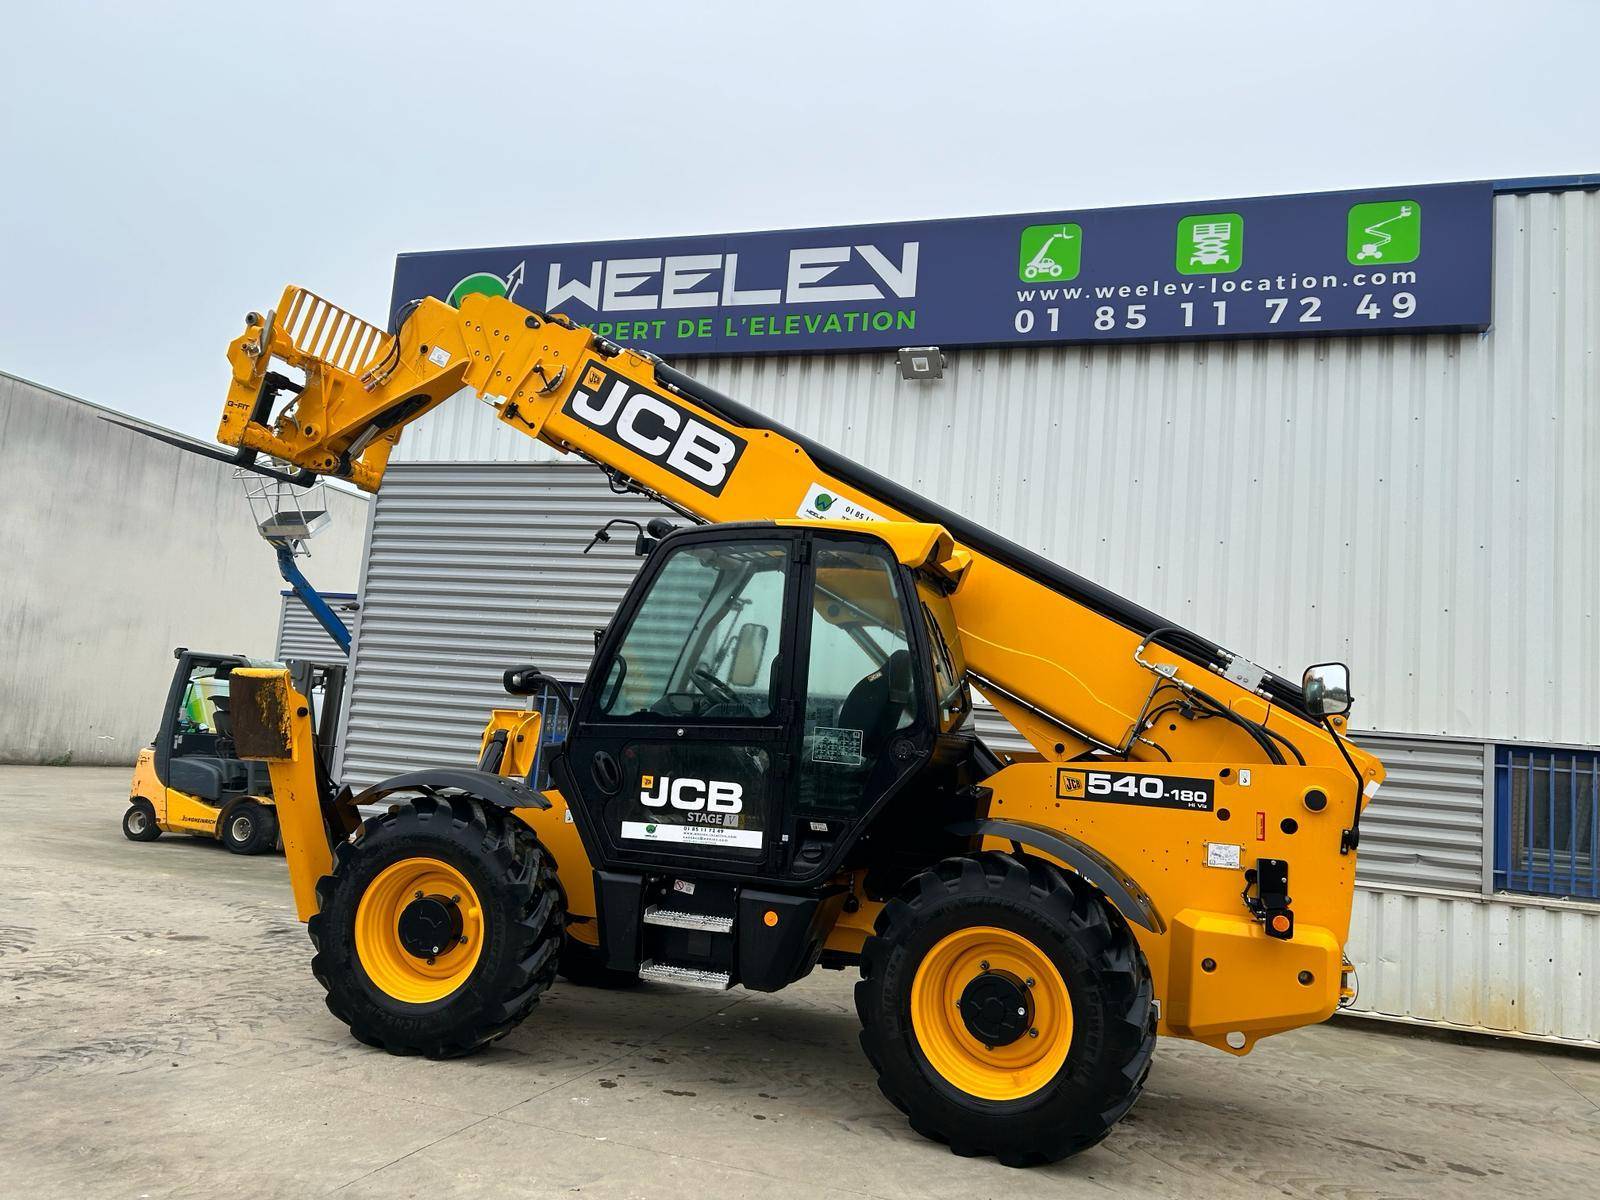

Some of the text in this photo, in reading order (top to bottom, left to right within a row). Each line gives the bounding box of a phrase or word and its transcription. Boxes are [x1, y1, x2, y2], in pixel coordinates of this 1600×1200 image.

[545, 241, 920, 313] WEELEV
[1016, 270, 1417, 302] www.weelev-location.com
[580, 310, 917, 341] PERT DE L'ELEVATION
[1014, 291, 1417, 334] 01 85 11 72 49
[571, 379, 737, 488] JCB
[845, 506, 854, 515] 01
[855, 510, 865, 520] 85
[640, 776, 743, 814] JCB
[1064, 776, 1082, 792] JCB
[1087, 772, 1207, 803] 540-180
[687, 811, 723, 825] STAGE
